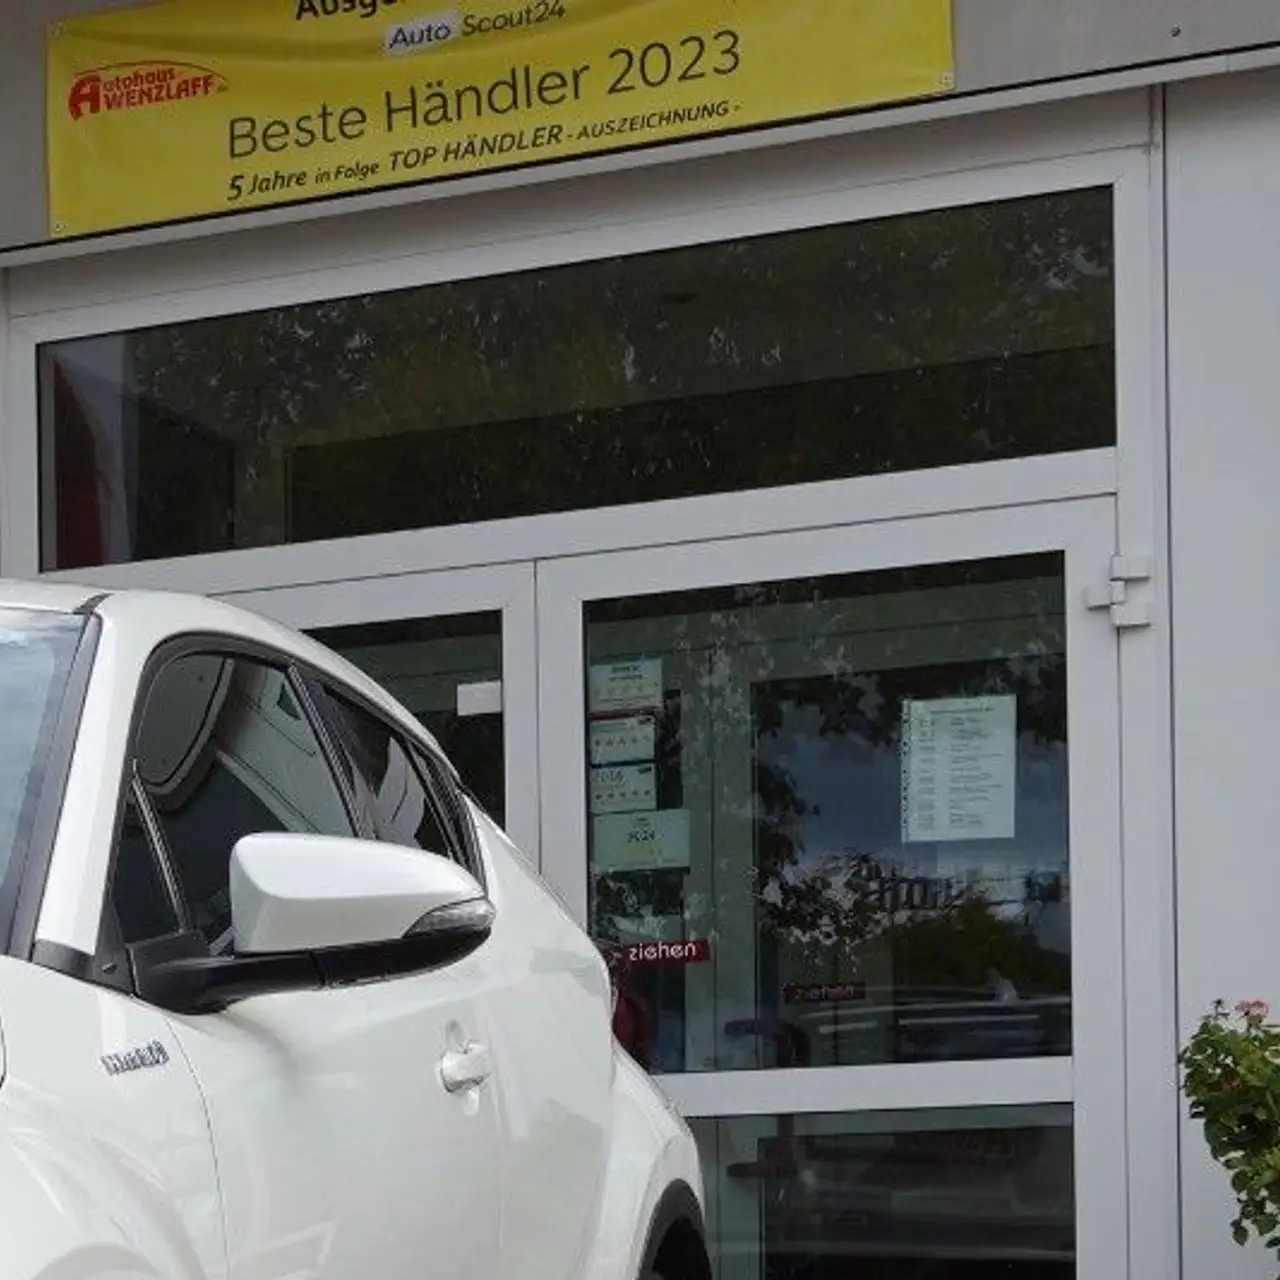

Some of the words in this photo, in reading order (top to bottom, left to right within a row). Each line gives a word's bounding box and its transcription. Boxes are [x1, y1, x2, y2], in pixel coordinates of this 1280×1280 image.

[296, 0, 395, 20] Ausg
[390, 23, 451, 49] Auto
[461, 3, 566, 37] Scout24
[229, 102, 367, 159] Beste
[384, 64, 590, 133] Händler
[607, 29, 741, 95] 2023
[227, 174, 244, 201] 5
[248, 170, 307, 196] Jahre
[315, 167, 331, 184] in
[333, 161, 380, 181] Folge
[389, 147, 437, 172] TOP
[628, 941, 697, 961] ziehen
